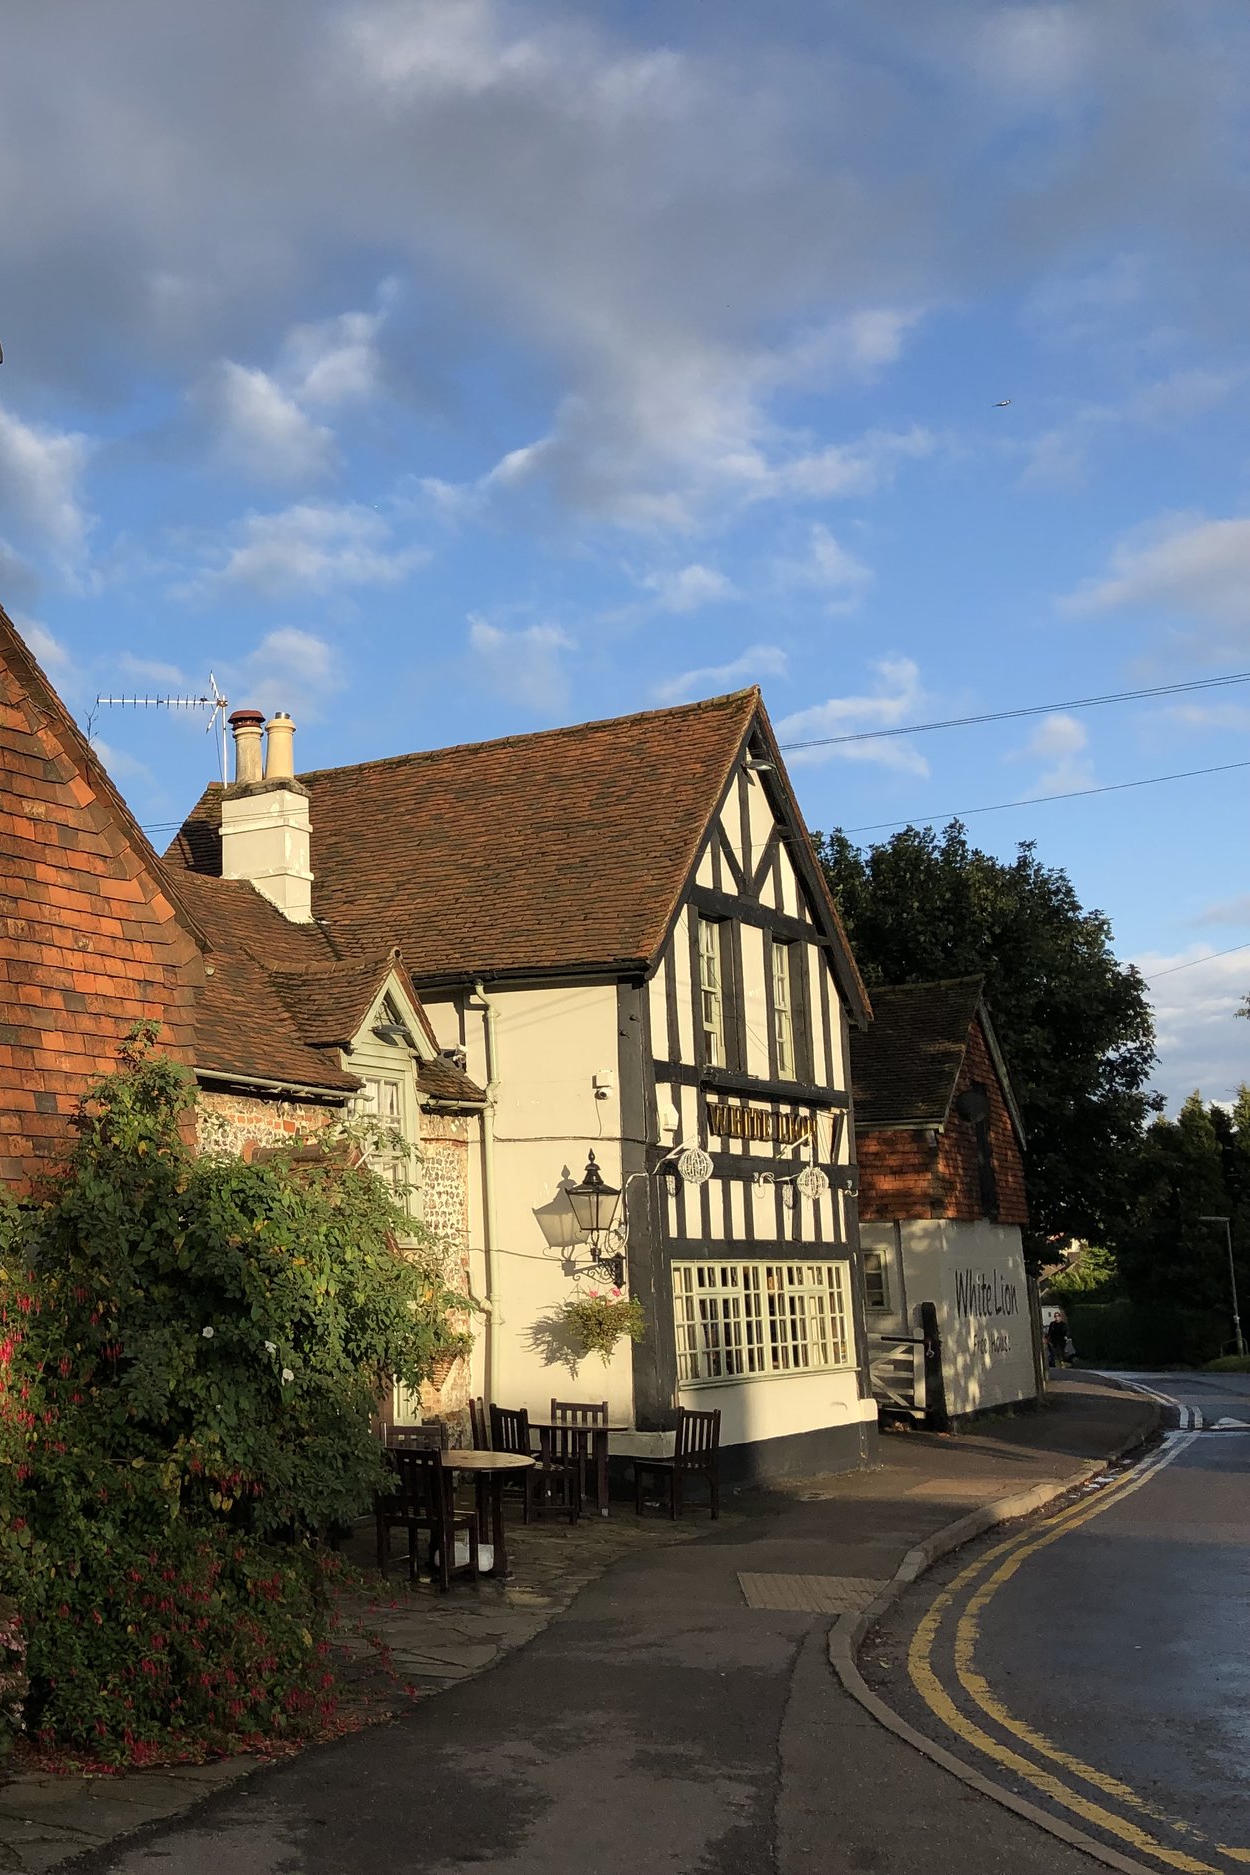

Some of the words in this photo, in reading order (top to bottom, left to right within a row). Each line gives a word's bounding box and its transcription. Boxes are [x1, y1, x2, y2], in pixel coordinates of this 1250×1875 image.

[708, 1103, 772, 1142] WHITE
[776, 1111, 817, 1147] LION
[955, 1268, 992, 1318] White
[994, 1269, 1019, 1316] Lion
[973, 1334, 986, 1354] Free
